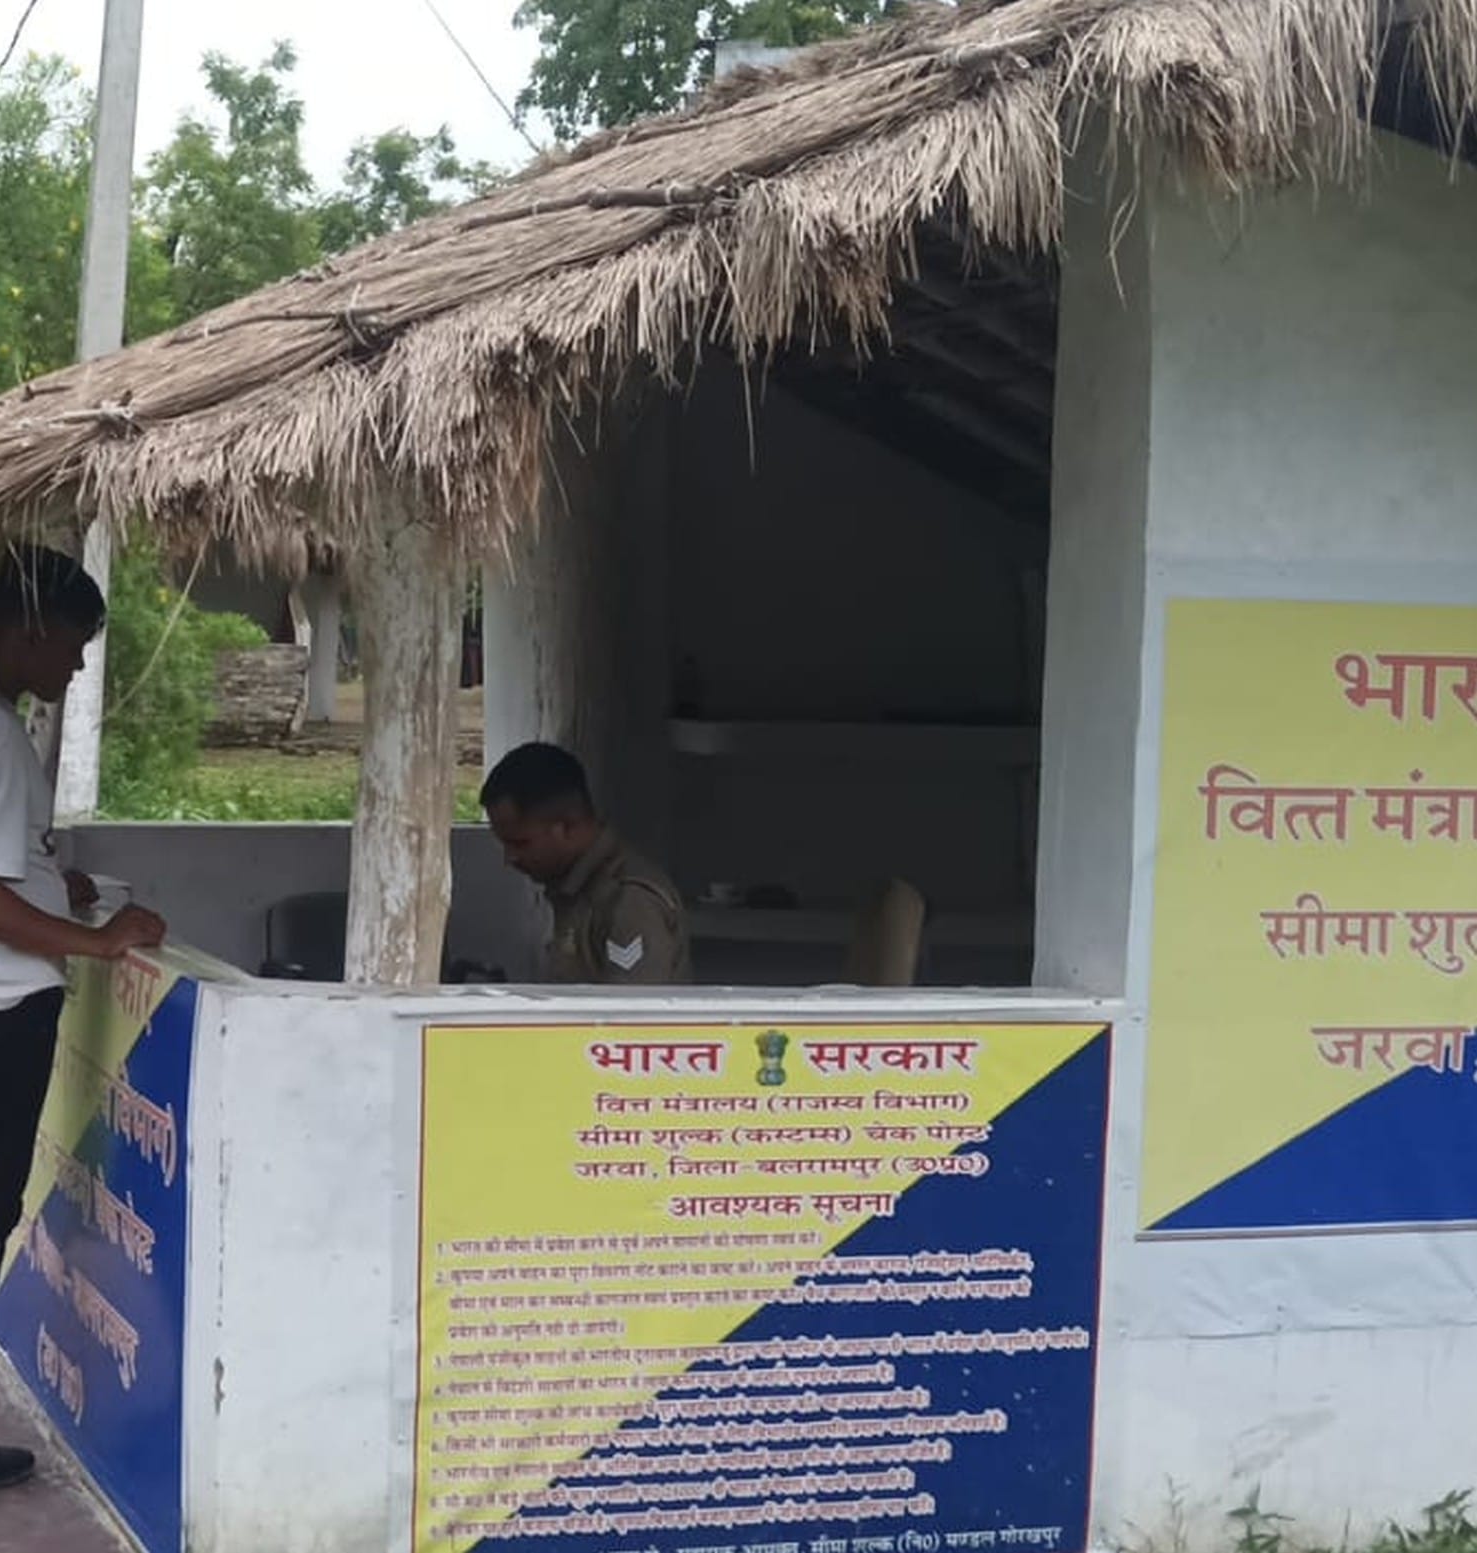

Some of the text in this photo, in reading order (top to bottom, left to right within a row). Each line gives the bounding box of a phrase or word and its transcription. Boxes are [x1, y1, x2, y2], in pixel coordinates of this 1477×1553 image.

[1335, 654, 1477, 721] भार
[1198, 763, 1477, 842] वित्त मंत्रा
[1260, 893, 1477, 974] सीमा शु
[589, 1040, 979, 1073] भारत सरकार
[596, 1091, 970, 1115] वित्त मंत्रालय (राजस्व विभाग)
[576, 1120, 987, 1150] सीमा शुल्क (कस्टम्स) चेक पोस्ट
[667, 1191, 894, 1221] आवश्यक सूचना
